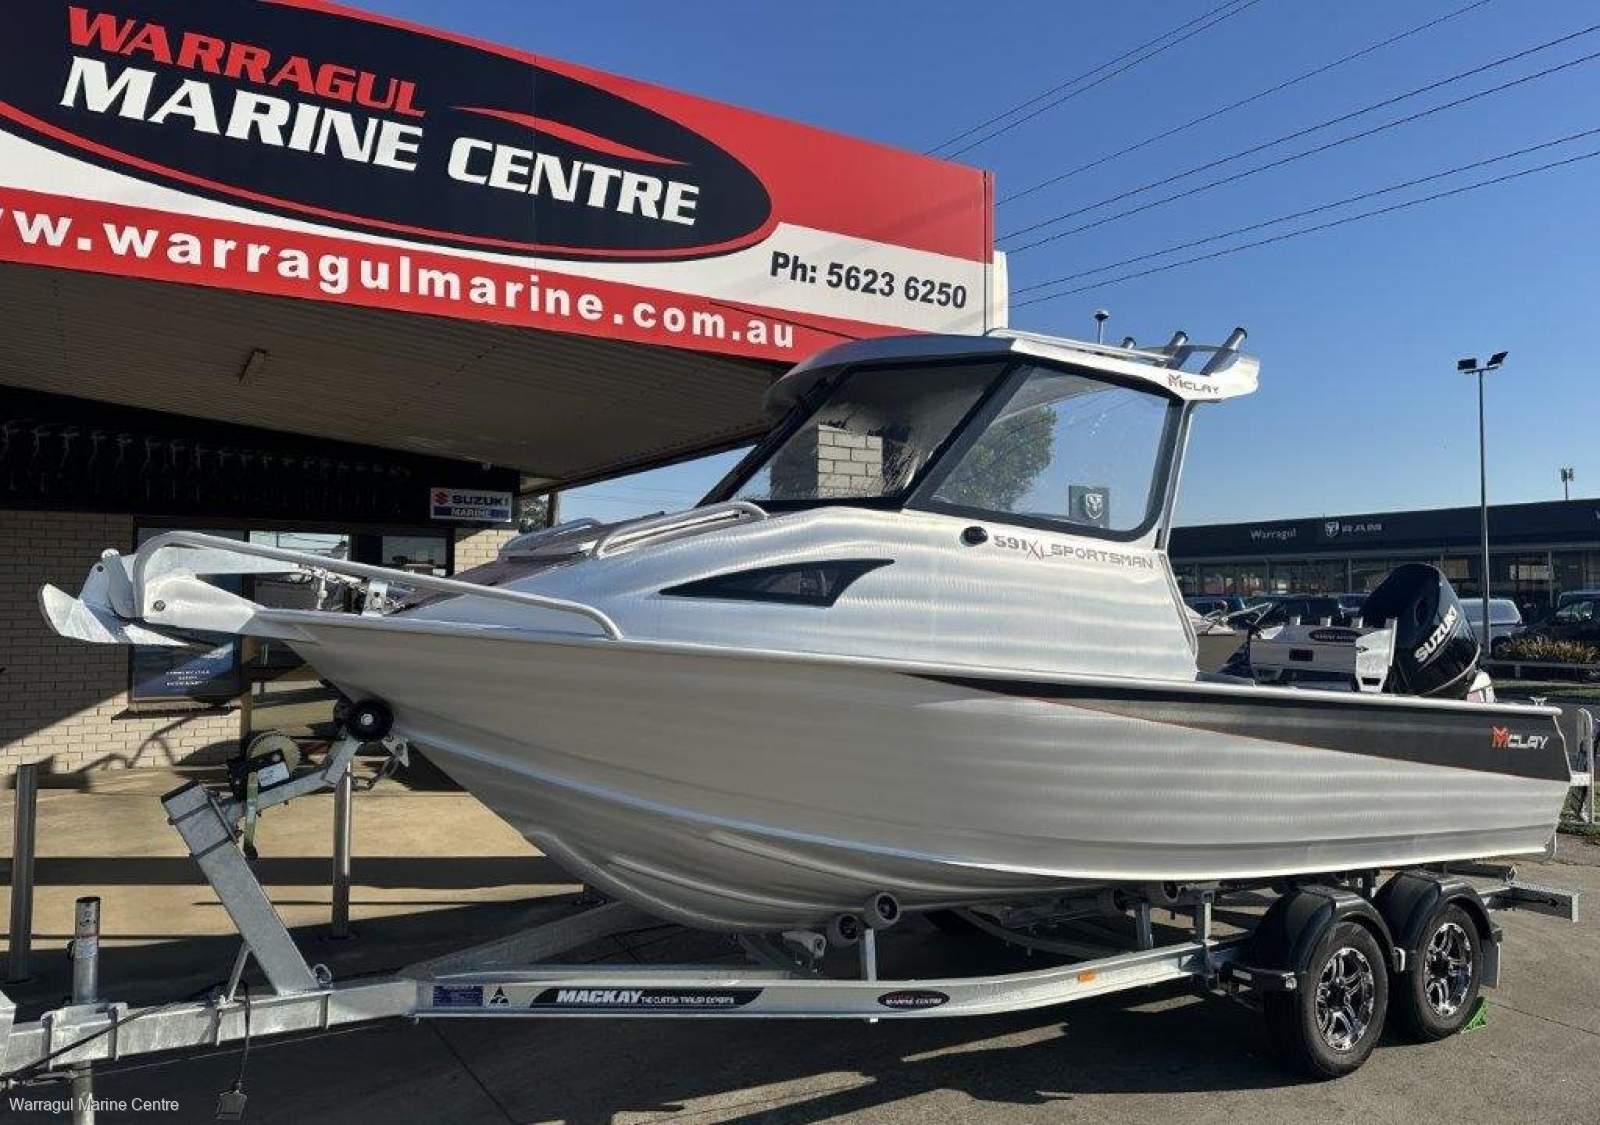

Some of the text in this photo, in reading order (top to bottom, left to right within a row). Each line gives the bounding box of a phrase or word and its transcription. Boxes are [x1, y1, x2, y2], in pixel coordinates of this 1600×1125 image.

[68, 6, 426, 118] WARRAGUL
[60, 56, 699, 226] MARINE CENTRE
[0, 207, 795, 348] w.warragulmarine.com.au
[770, 251, 968, 309] Ph: 5623 6250
[452, 494, 509, 506] SUZUKI
[1250, 527, 1297, 540] Warragul
[1050, 543, 1154, 570] SPORTSMAN
[556, 989, 643, 1003] MACKAY
